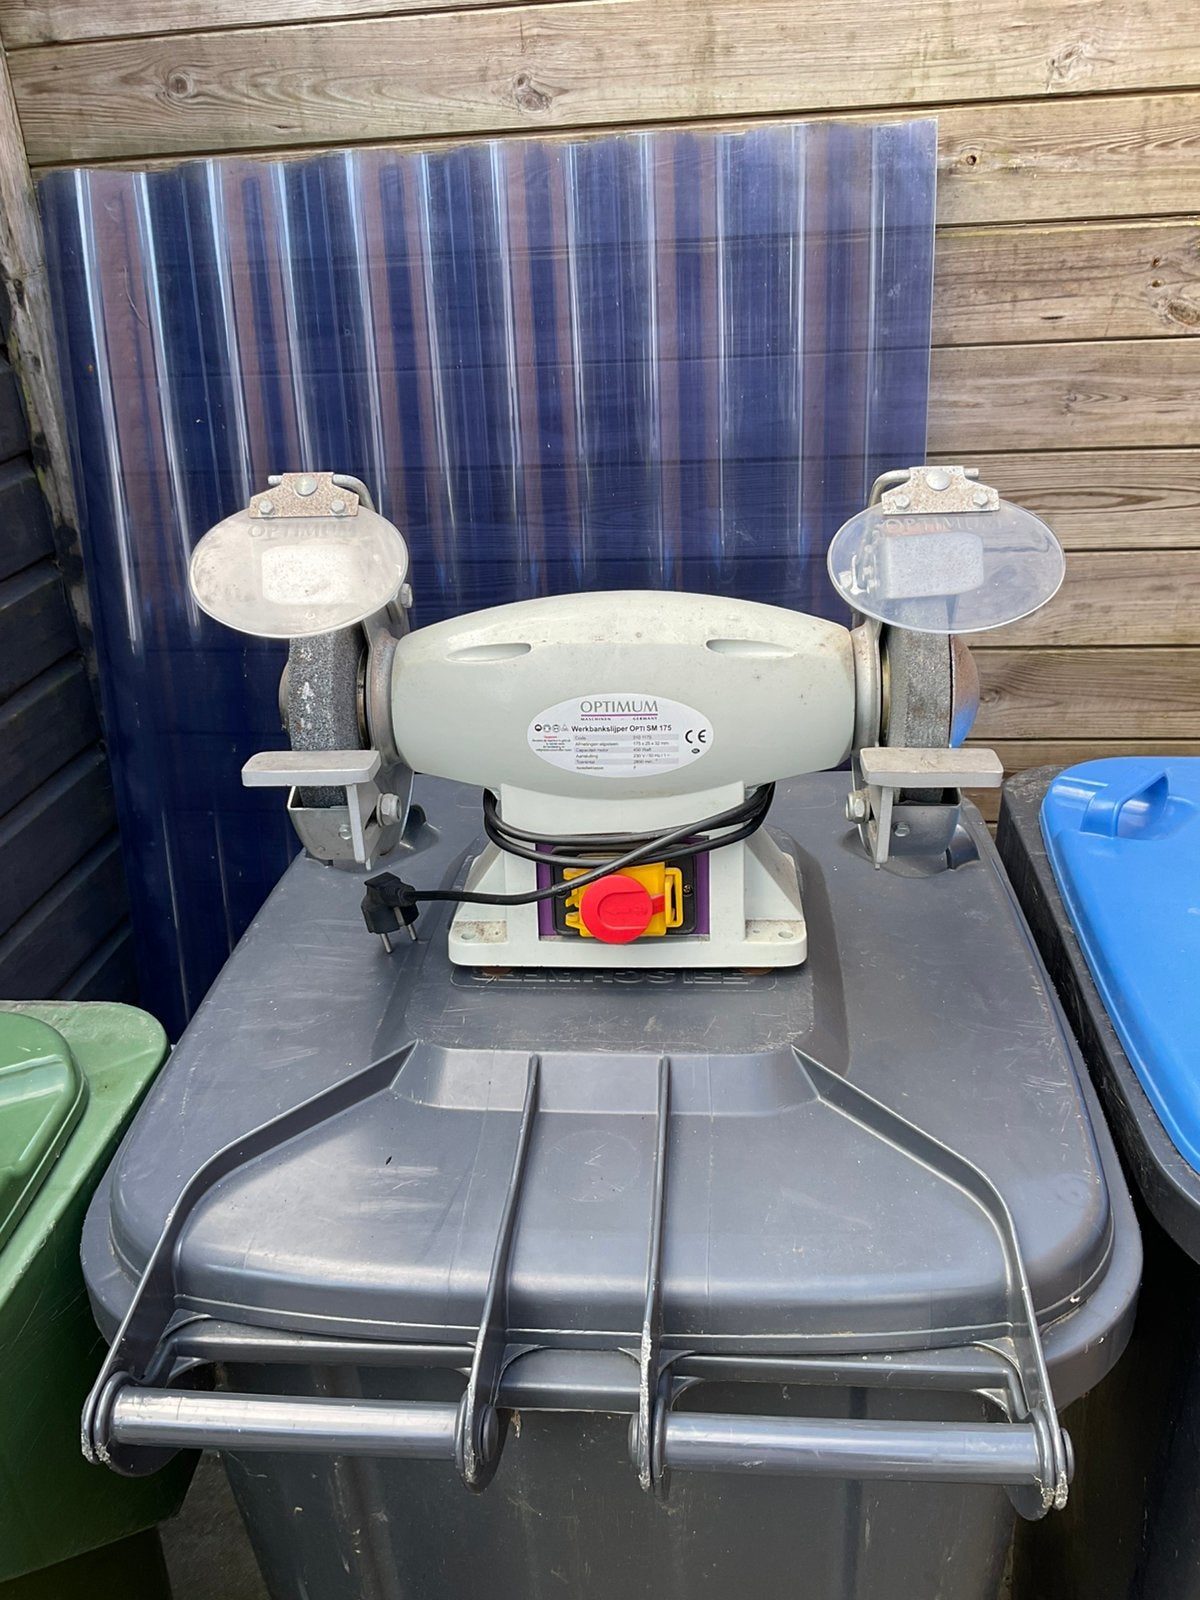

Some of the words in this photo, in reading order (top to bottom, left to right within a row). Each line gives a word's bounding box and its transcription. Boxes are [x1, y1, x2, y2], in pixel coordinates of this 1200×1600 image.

[248, 524, 358, 538] OPTIMUM
[580, 700, 658, 712] OPTIMUM
[572, 725, 628, 733] Werkbankslijper
